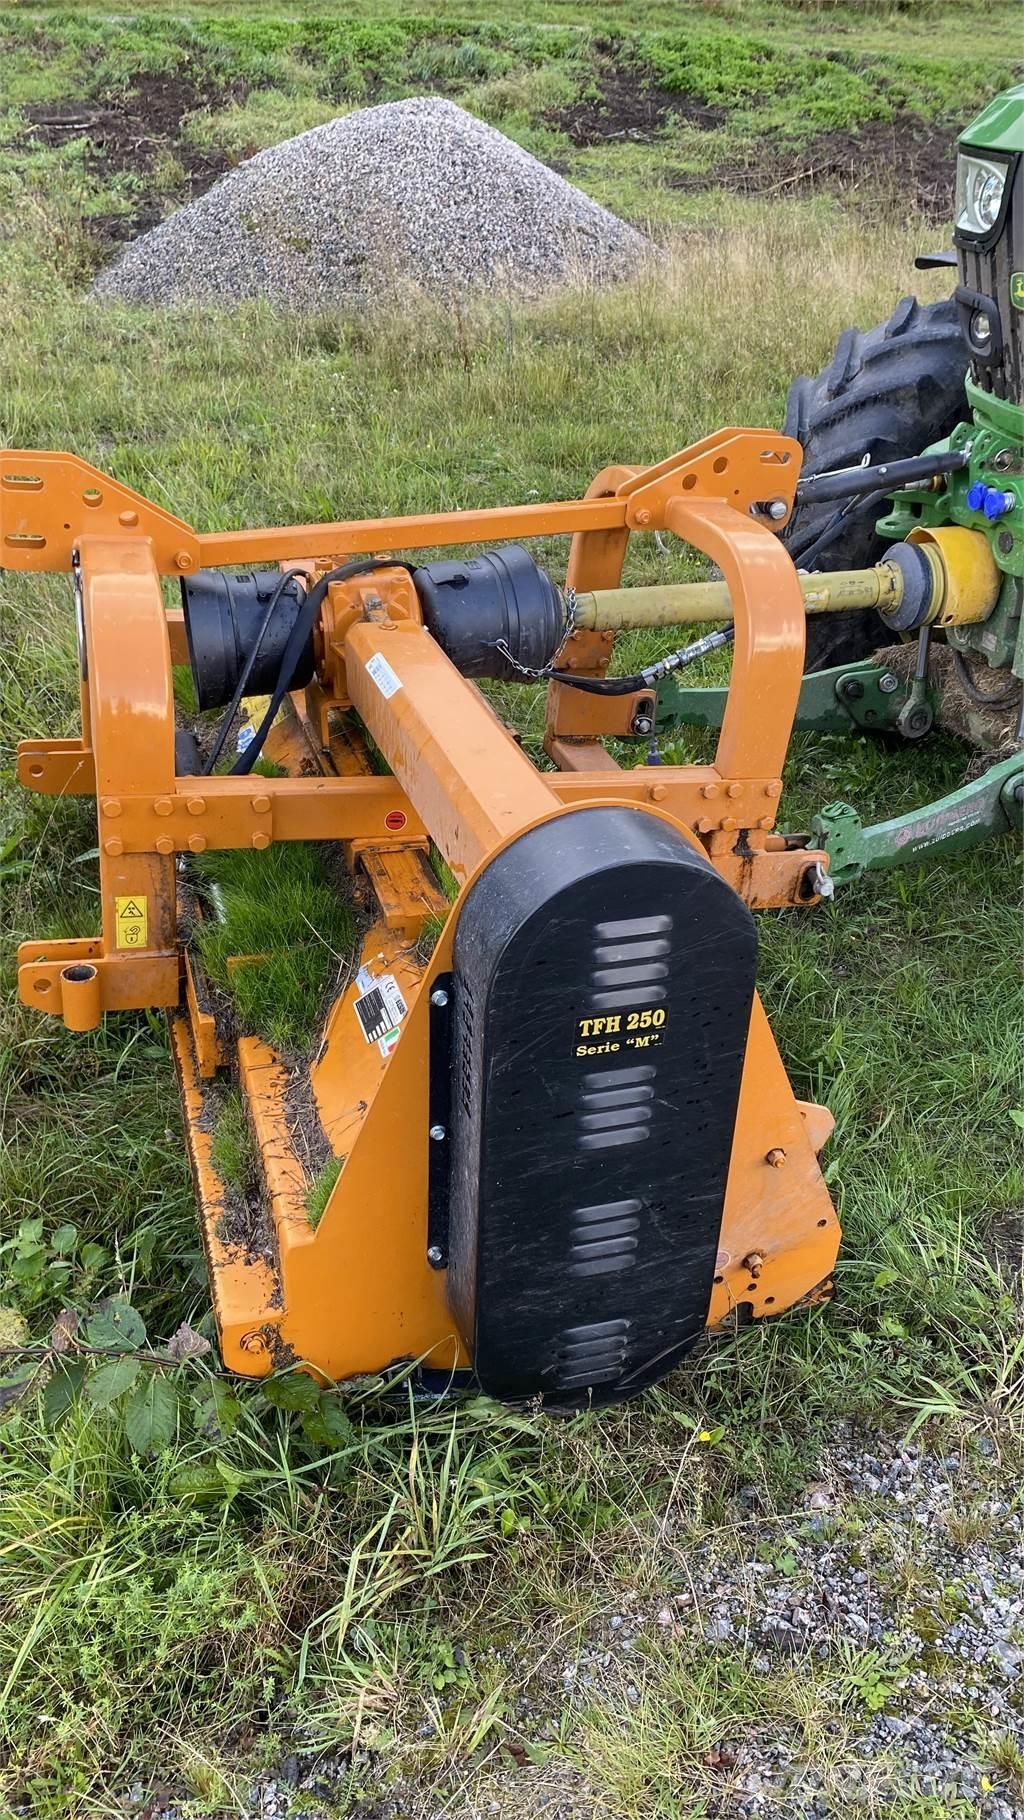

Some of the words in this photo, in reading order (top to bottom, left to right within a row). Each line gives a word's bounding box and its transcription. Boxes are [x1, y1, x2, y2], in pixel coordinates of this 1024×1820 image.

[579, 1015, 621, 1037] TFH
[626, 1009, 666, 1030] 250
[576, 1042, 620, 1057] Serie
